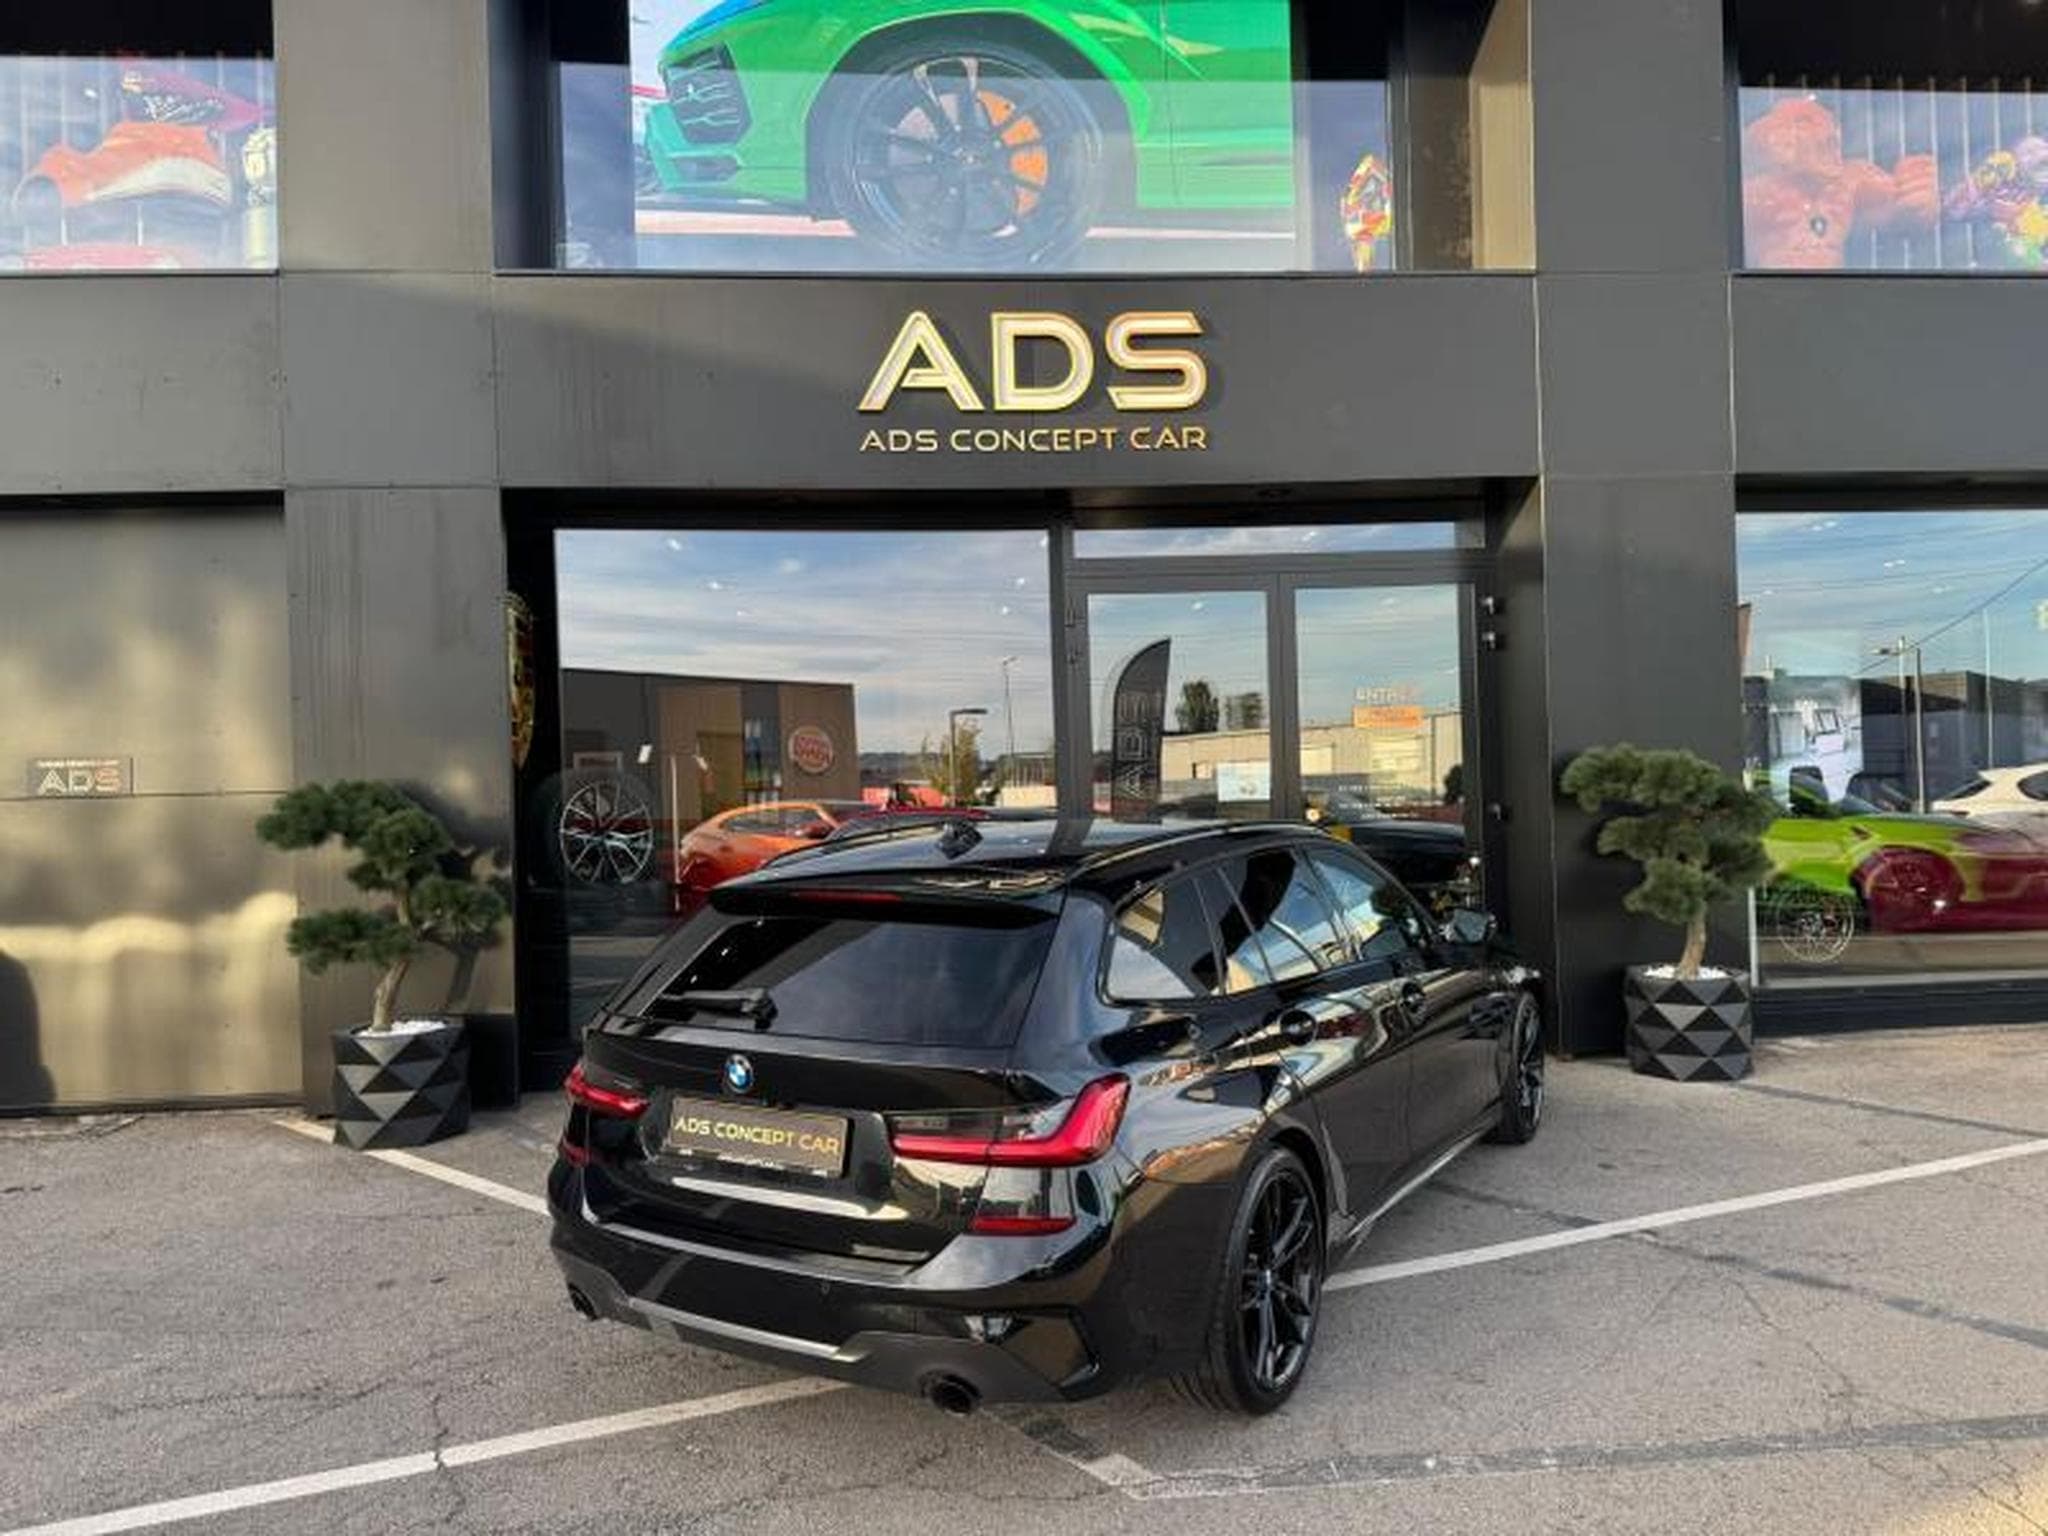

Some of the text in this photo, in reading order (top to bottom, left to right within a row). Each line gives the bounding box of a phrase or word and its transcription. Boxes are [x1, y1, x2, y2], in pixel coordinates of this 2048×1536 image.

[857, 311, 1206, 411] ADS
[860, 427, 1206, 452] ADS CONCEPT CAR
[38, 769, 122, 796] ADS
[674, 1117, 840, 1156] ADS CONCEPT CAR
